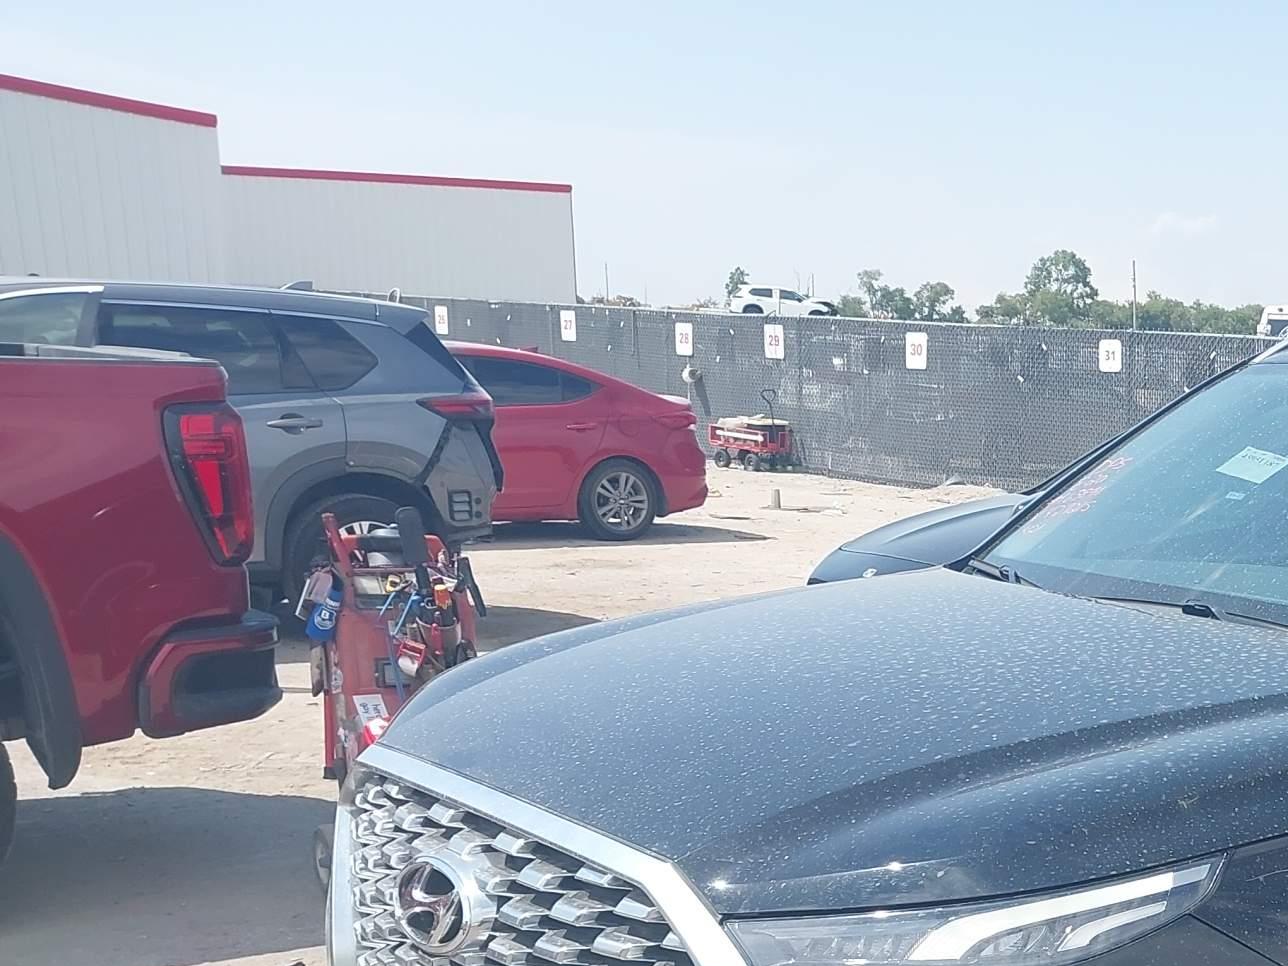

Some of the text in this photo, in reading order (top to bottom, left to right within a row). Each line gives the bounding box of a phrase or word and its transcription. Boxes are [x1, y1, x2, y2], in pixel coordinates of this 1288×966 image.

[563, 319, 573, 330] 27
[679, 332, 690, 344] 28
[768, 334, 780, 347] 29
[910, 343, 923, 357] 30
[1104, 349, 1116, 361] 31
